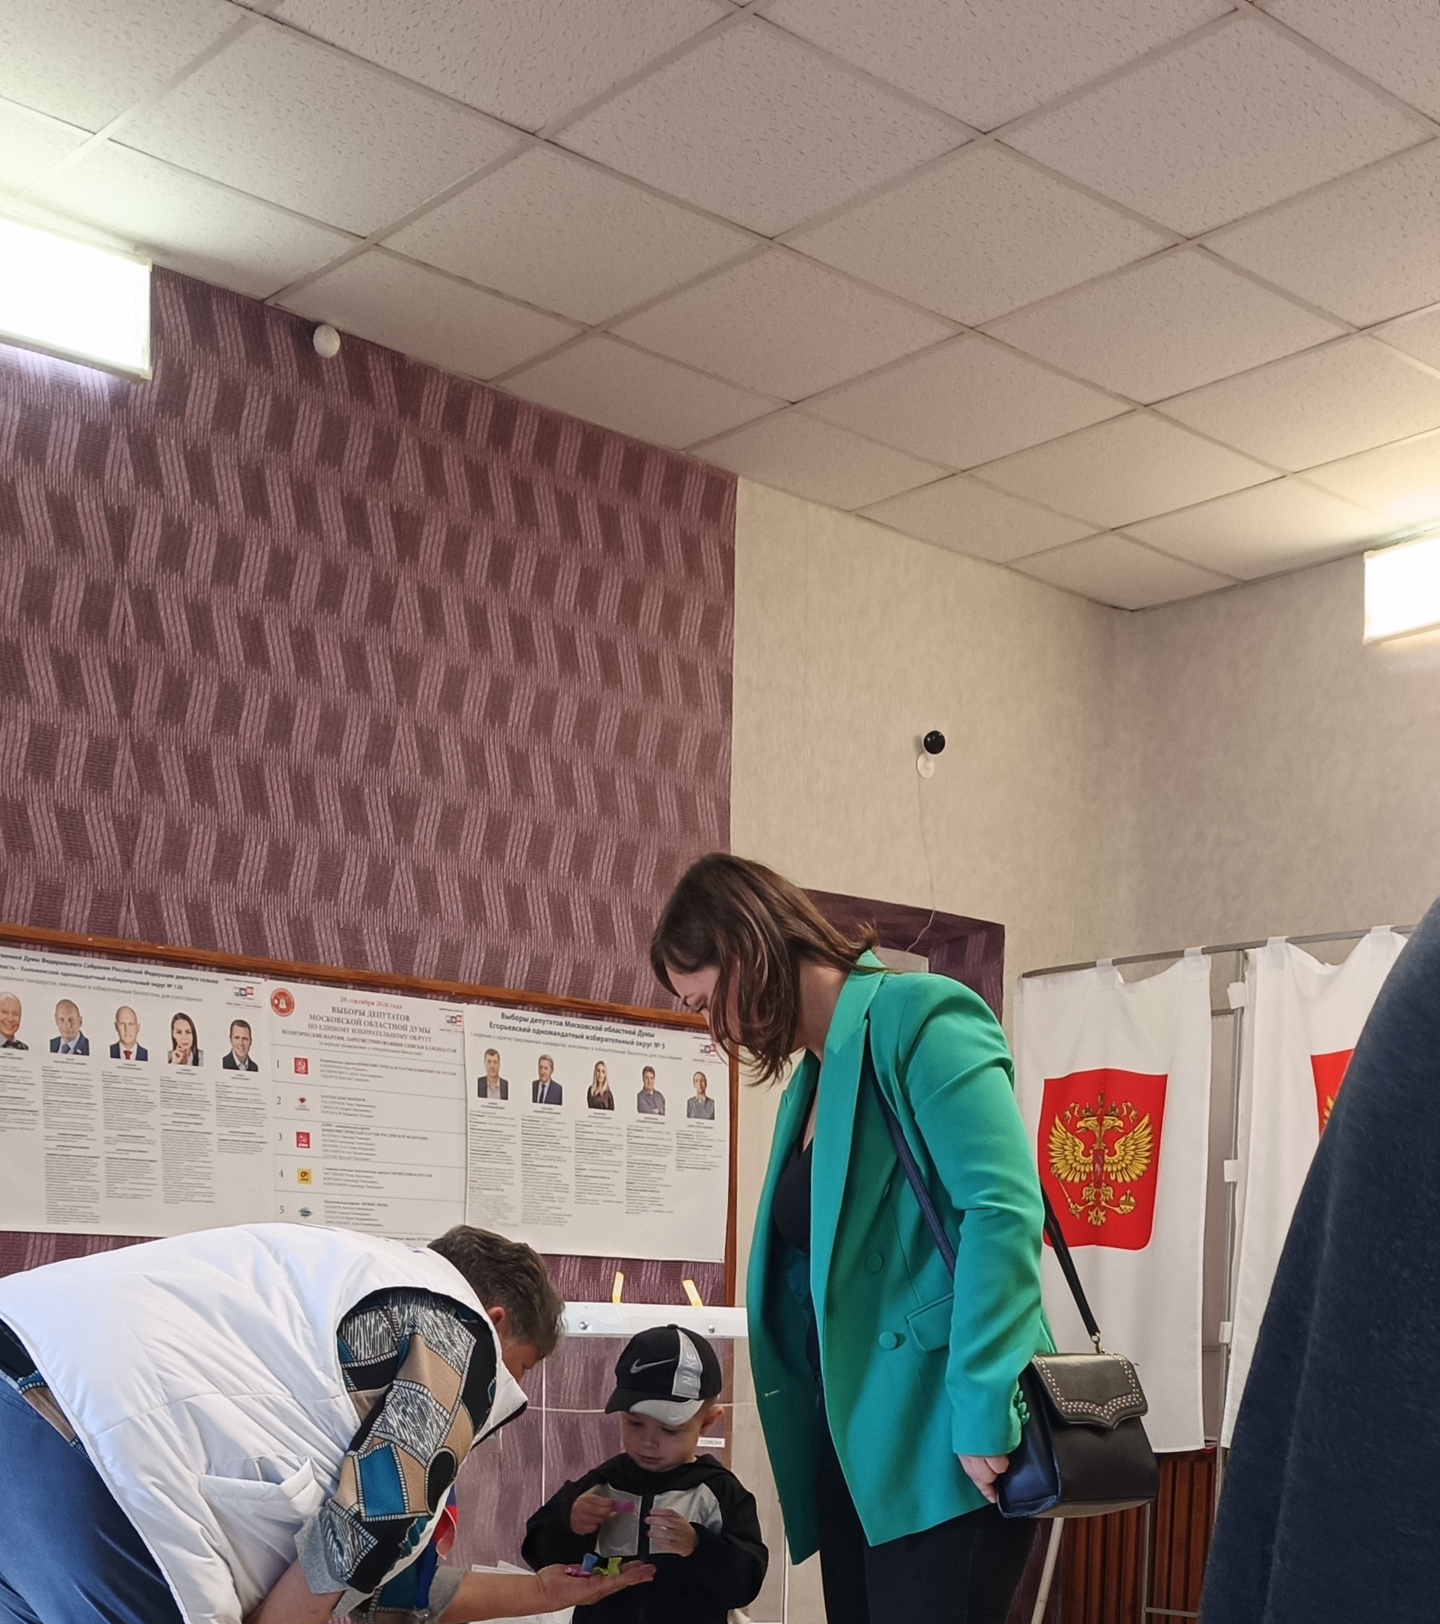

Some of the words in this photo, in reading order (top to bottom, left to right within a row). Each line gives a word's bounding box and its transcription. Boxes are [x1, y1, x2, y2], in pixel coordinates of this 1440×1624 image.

[20, 966, 59, 975] Коломенский
[60, 971, 106, 981] одномандатный
[107, 977, 150, 986] избирательный
[23, 955, 40, 963] Думы
[42, 958, 82, 968] Федерального
[84, 962, 110, 971] Собрания
[112, 966, 142, 974] Российской
[144, 970, 174, 980] Федерации
[332, 1006, 365, 1017] ВЫБОРЫ
[367, 1010, 410, 1021] ДЕПУТАТОВ
[309, 1014, 361, 1026] МОСКОВСКОЙ
[364, 1020, 408, 1031] ОБЛАСТНОЙ
[409, 1026, 431, 1034] ДУМЫ
[320, 1024, 349, 1033] ЕДИНОМУ
[351, 1027, 408, 1039] ИЗБИРАТЕЛЬНОМУ
[489, 1022, 531, 1033] Егорьевский
[532, 1028, 584, 1040] одномандатный
[586, 1033, 634, 1045] избирательный
[501, 1012, 529, 1023] Выборы
[530, 1016, 563, 1027] депутатов
[565, 1021, 602, 1032] Московской
[604, 1026, 636, 1035] областной
[637, 1030, 655, 1038] Думы
[276, 1096, 282, 1105] 2
[278, 1132, 283, 1141] 3
[280, 1205, 284, 1214] 5
[682, 1352, 697, 1386] NIKE
